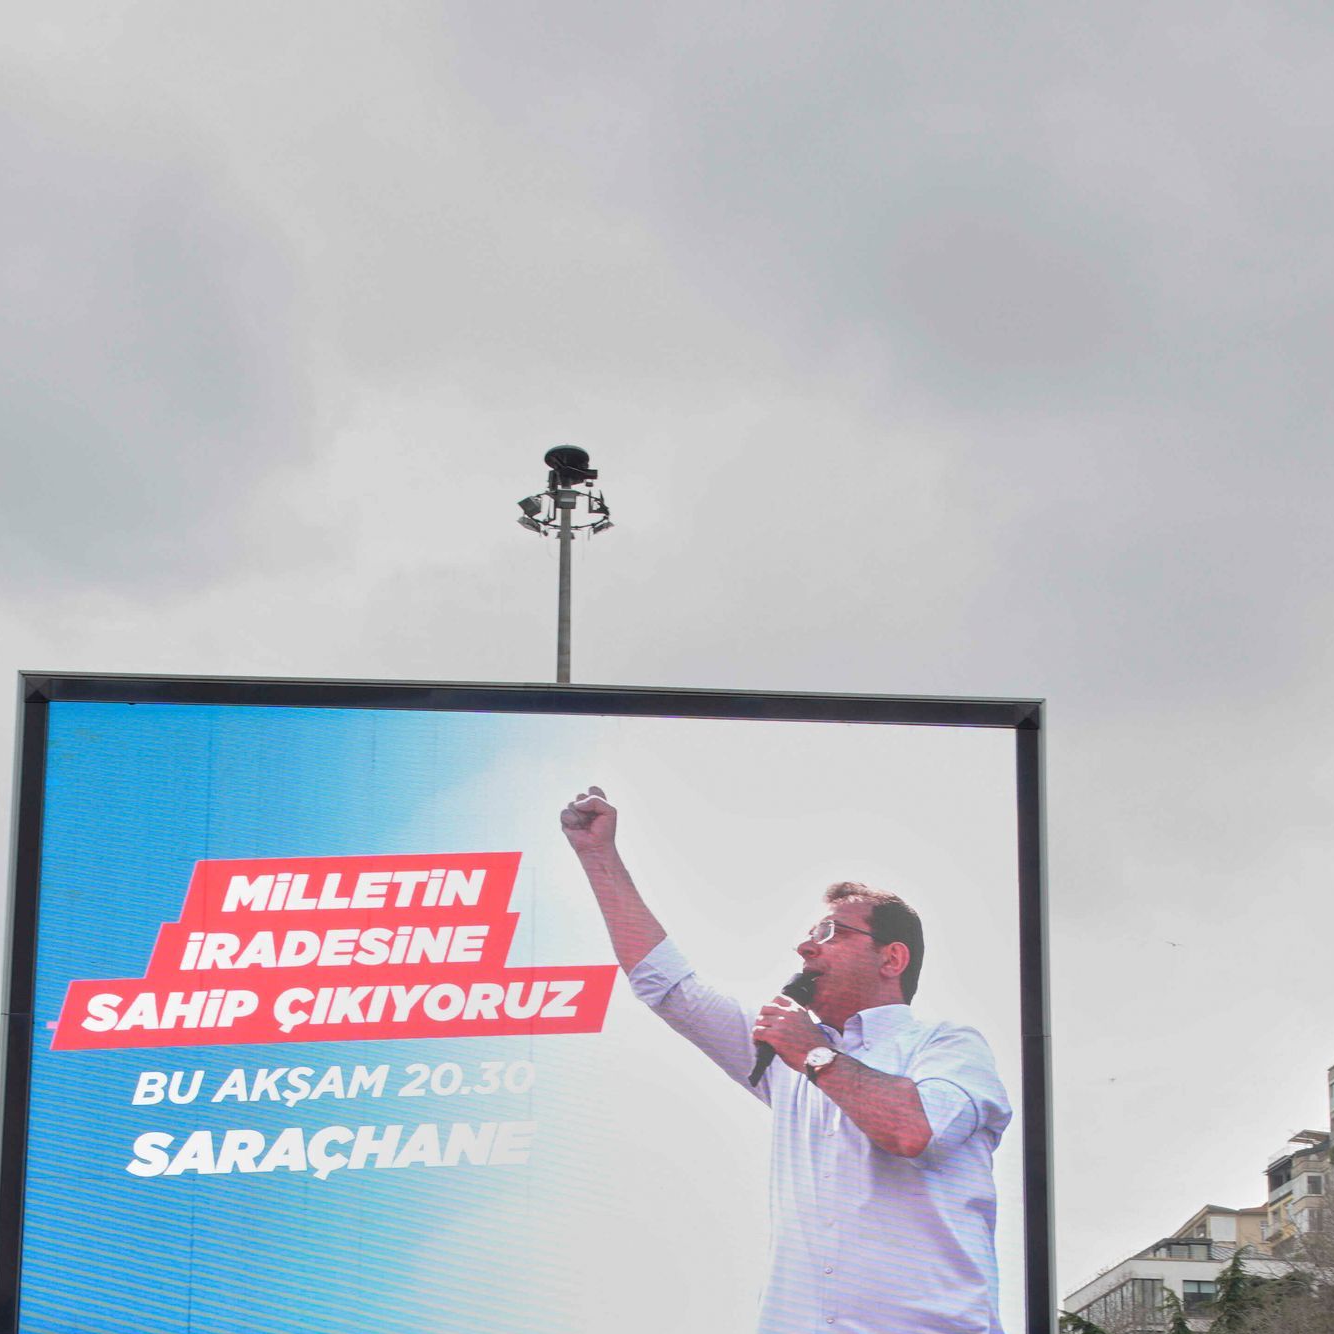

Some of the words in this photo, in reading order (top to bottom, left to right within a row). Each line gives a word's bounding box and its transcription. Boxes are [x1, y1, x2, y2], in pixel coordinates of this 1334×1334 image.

[221, 868, 487, 914] MİLLETİN
[180, 924, 490, 971] İRADESİNE
[82, 989, 259, 1033] SAHİP
[274, 980, 585, 1034] ÇIKIYORUZ
[131, 1070, 204, 1107] BU
[212, 1064, 390, 1109] AKŞAM
[396, 1060, 536, 1098] 20.30
[126, 1120, 539, 1181] SARAÇHANE
